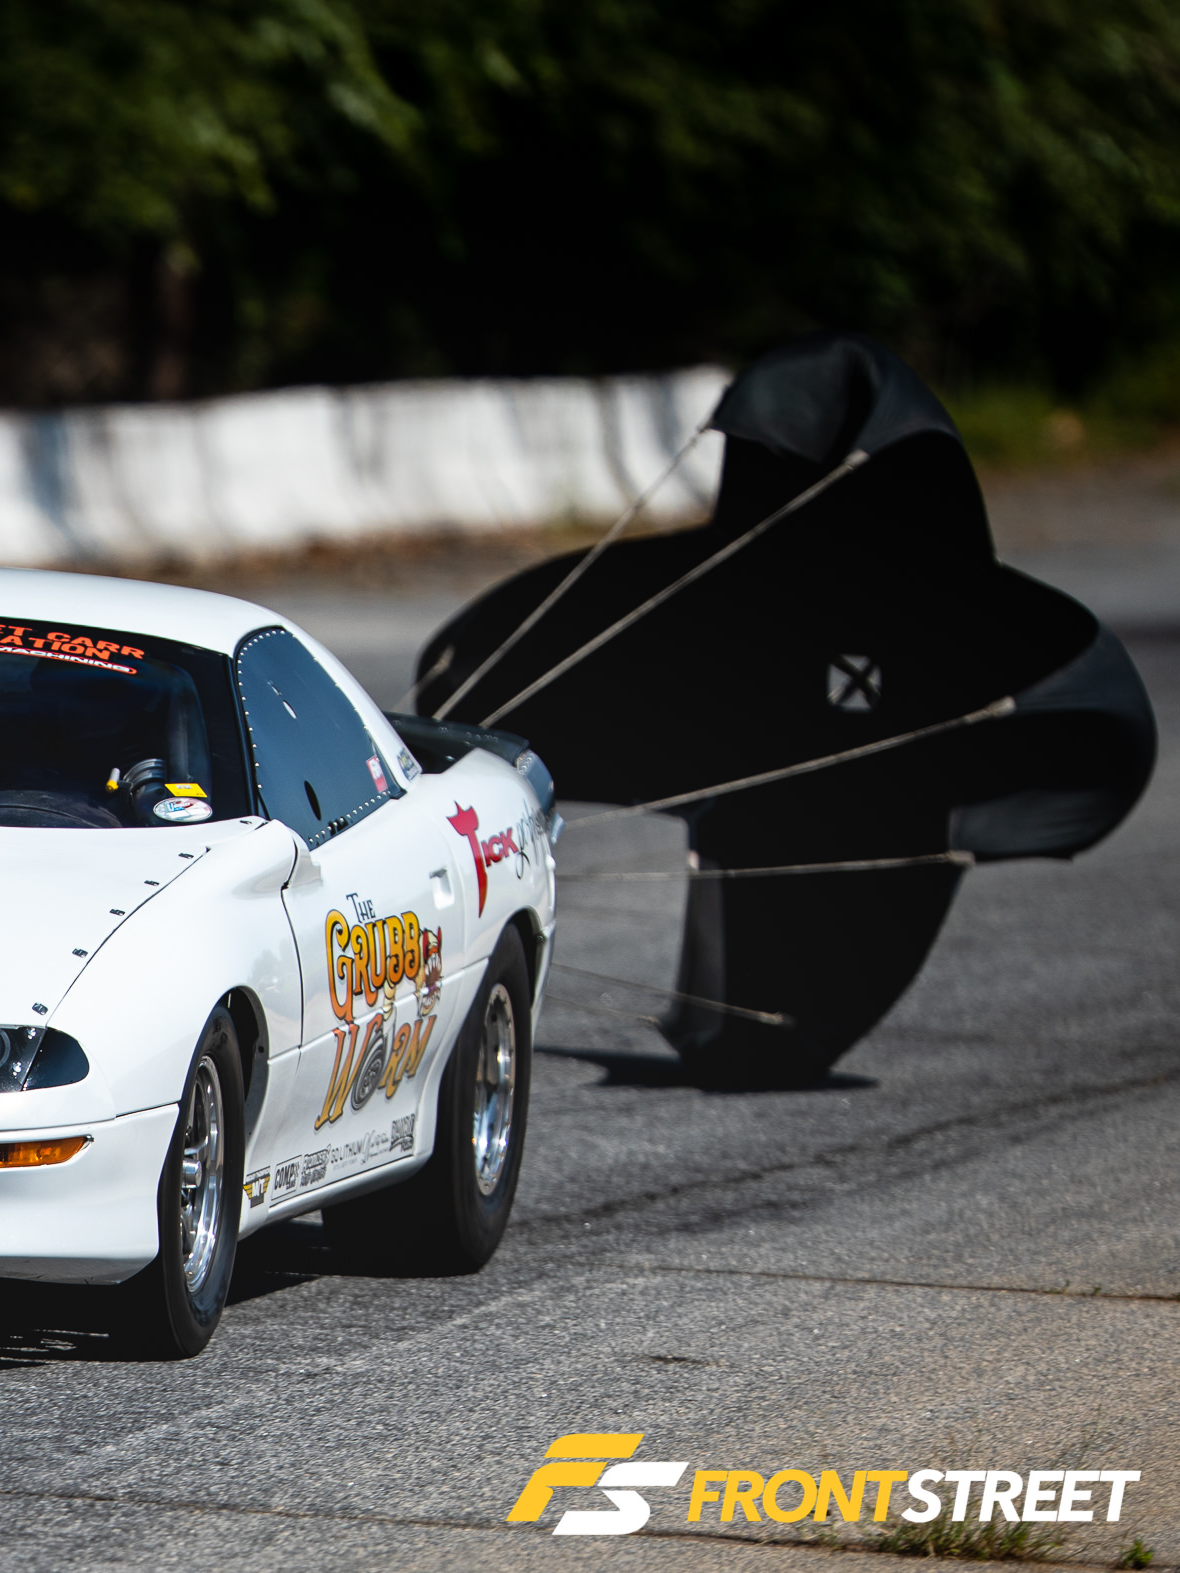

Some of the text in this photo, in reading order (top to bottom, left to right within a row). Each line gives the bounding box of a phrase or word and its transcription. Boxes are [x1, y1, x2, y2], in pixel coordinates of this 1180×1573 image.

[47, 631, 145, 659] CARR
[346, 892, 376, 924] THE
[325, 908, 421, 1025] GRUBB
[314, 1012, 438, 1131] WORM
